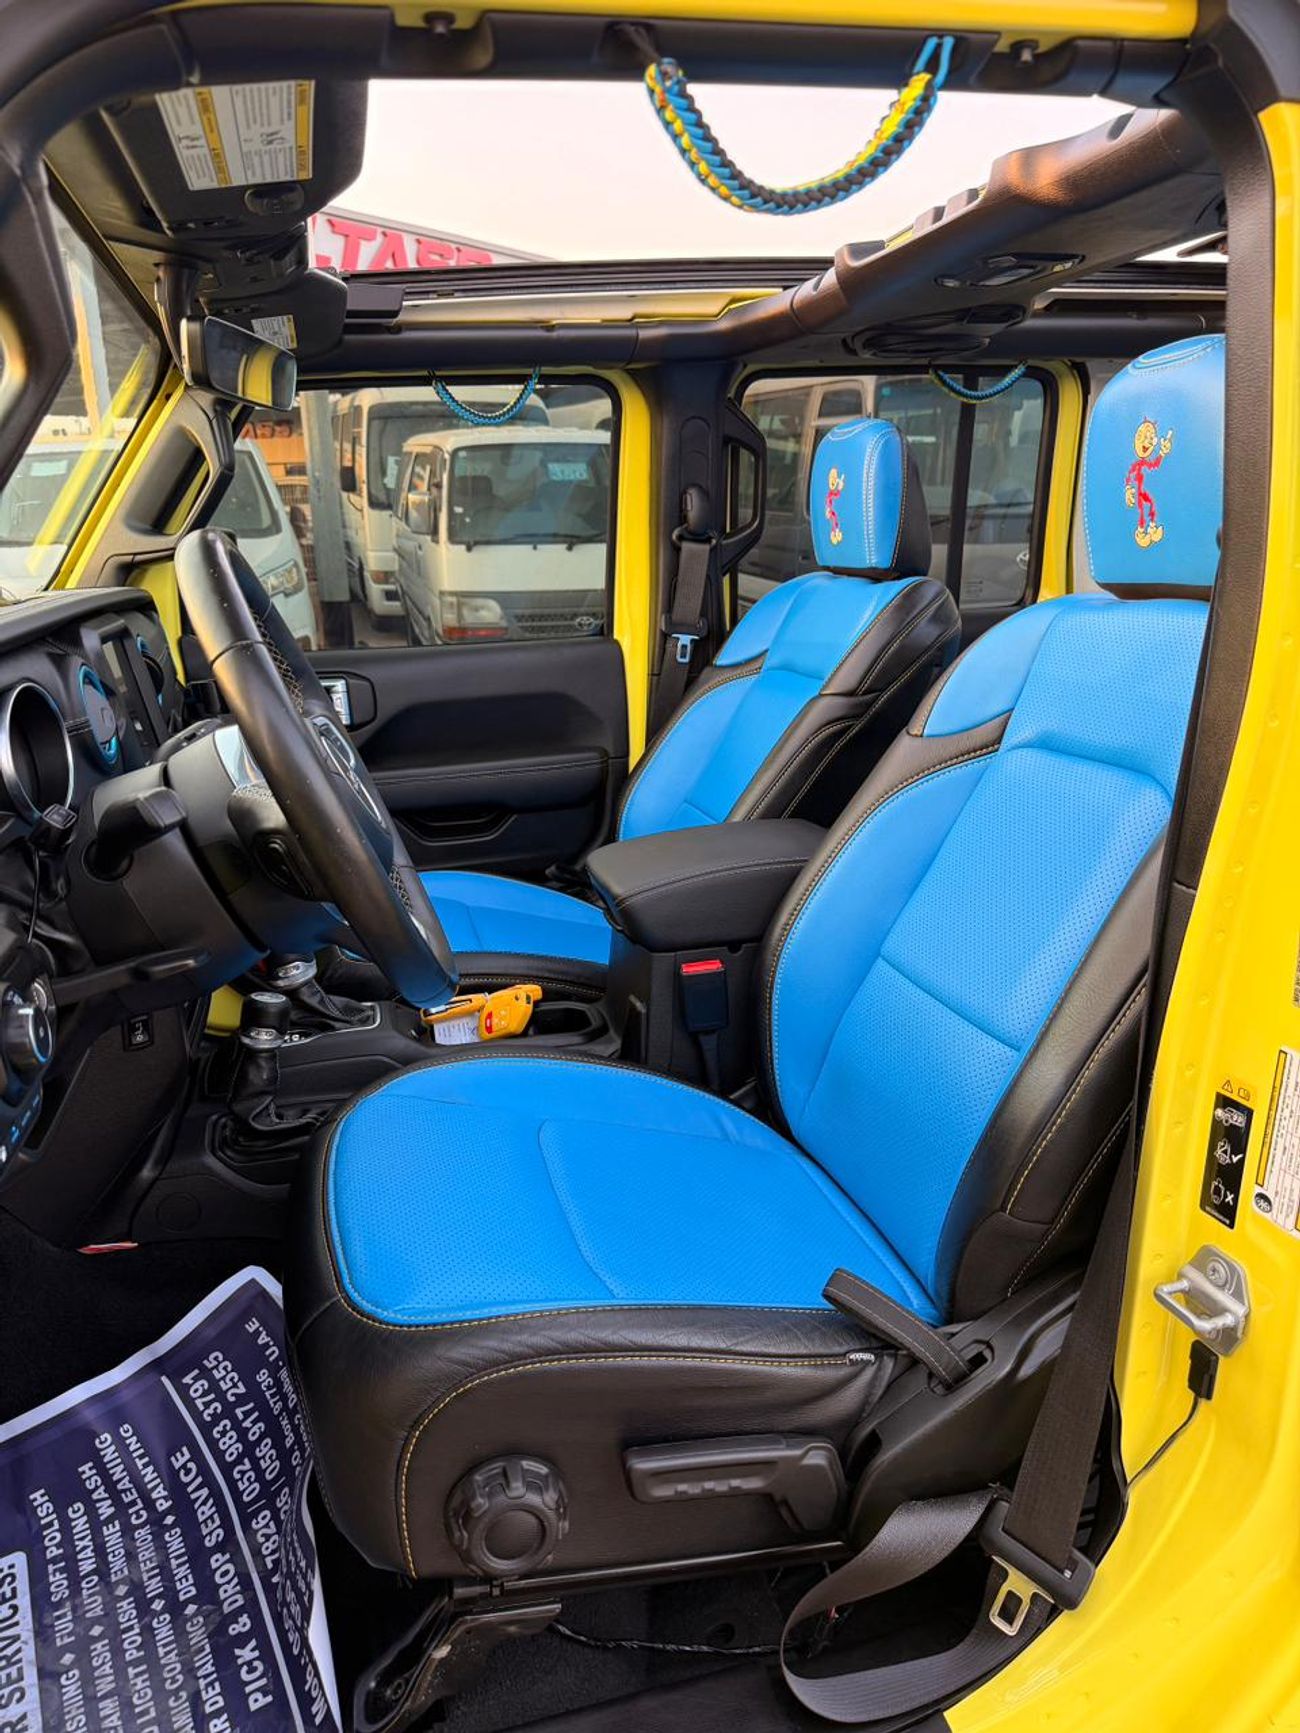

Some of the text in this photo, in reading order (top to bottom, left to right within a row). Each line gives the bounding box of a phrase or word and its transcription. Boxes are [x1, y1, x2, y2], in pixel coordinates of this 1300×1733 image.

[311, 214, 493, 273] TAS
[244, 1317, 280, 1362] U.A.E
[182, 1369, 223, 1422] 3791
[202, 1351, 247, 1402] 2555
[256, 1368, 283, 1416] 97736
[212, 1419, 243, 1463] 983
[235, 1402, 265, 1442] 917
[279, 1411, 295, 1449] Box:
[95, 1432, 148, 1525] CLEANING
[233, 1457, 260, 1502] 052
[255, 1437, 281, 1481] 056
[78, 1461, 116, 1520] WASH
[68, 1501, 98, 1577] WAXING
[102, 1519, 129, 1583] ENGINE
[134, 1523, 164, 1599] INTERIOR
[251, 1509, 281, 1571] 7826
[81, 1575, 105, 1619] AUTO
[120, 1423, 233, 1733] R DETAILING DENTING PAINTING
[171, 1446, 273, 1713] PICK & DROP SERVICE
[29, 1488, 88, 1733] SHING FULL SOFT POLISH
[116, 1597, 145, 1662] POLISH
[90, 1638, 117, 1698] WASH
[152, 1613, 184, 1690] COATING
[128, 1664, 157, 1724] LIGHT
